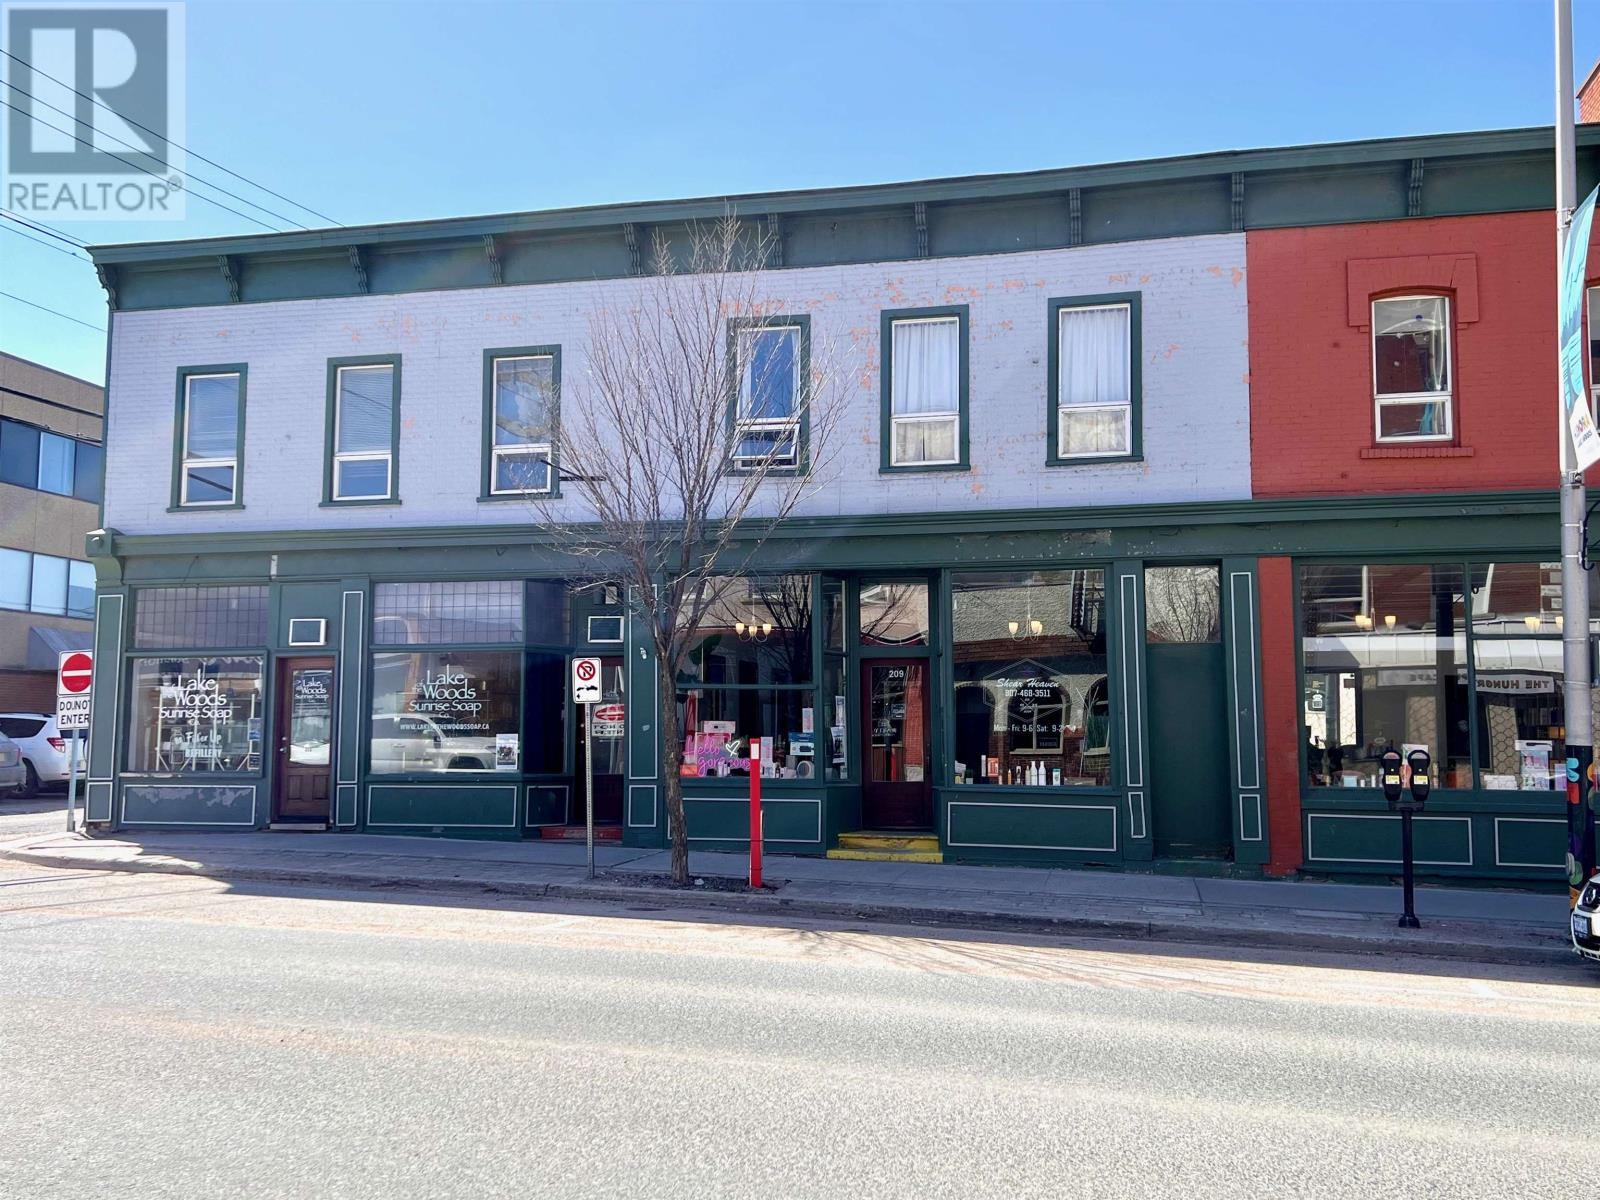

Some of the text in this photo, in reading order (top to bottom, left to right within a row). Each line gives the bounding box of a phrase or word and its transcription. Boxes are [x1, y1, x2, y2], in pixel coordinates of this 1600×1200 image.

[178, 668, 217, 690] Lake
[302, 676, 321, 687] Lake
[426, 664, 465, 685] Lake
[888, 669, 904, 678] 209
[996, 677, 1059, 688] Shear Heaven
[174, 684, 227, 706] Woods
[301, 684, 327, 694] Woods
[422, 678, 477, 700] Woods
[59, 700, 90, 711] DO NO
[408, 699, 482, 717] Sunrise Soap
[61, 714, 90, 725] ENTER
[159, 705, 232, 725] Sunrise Soap
[682, 735, 720, 760] Hello
